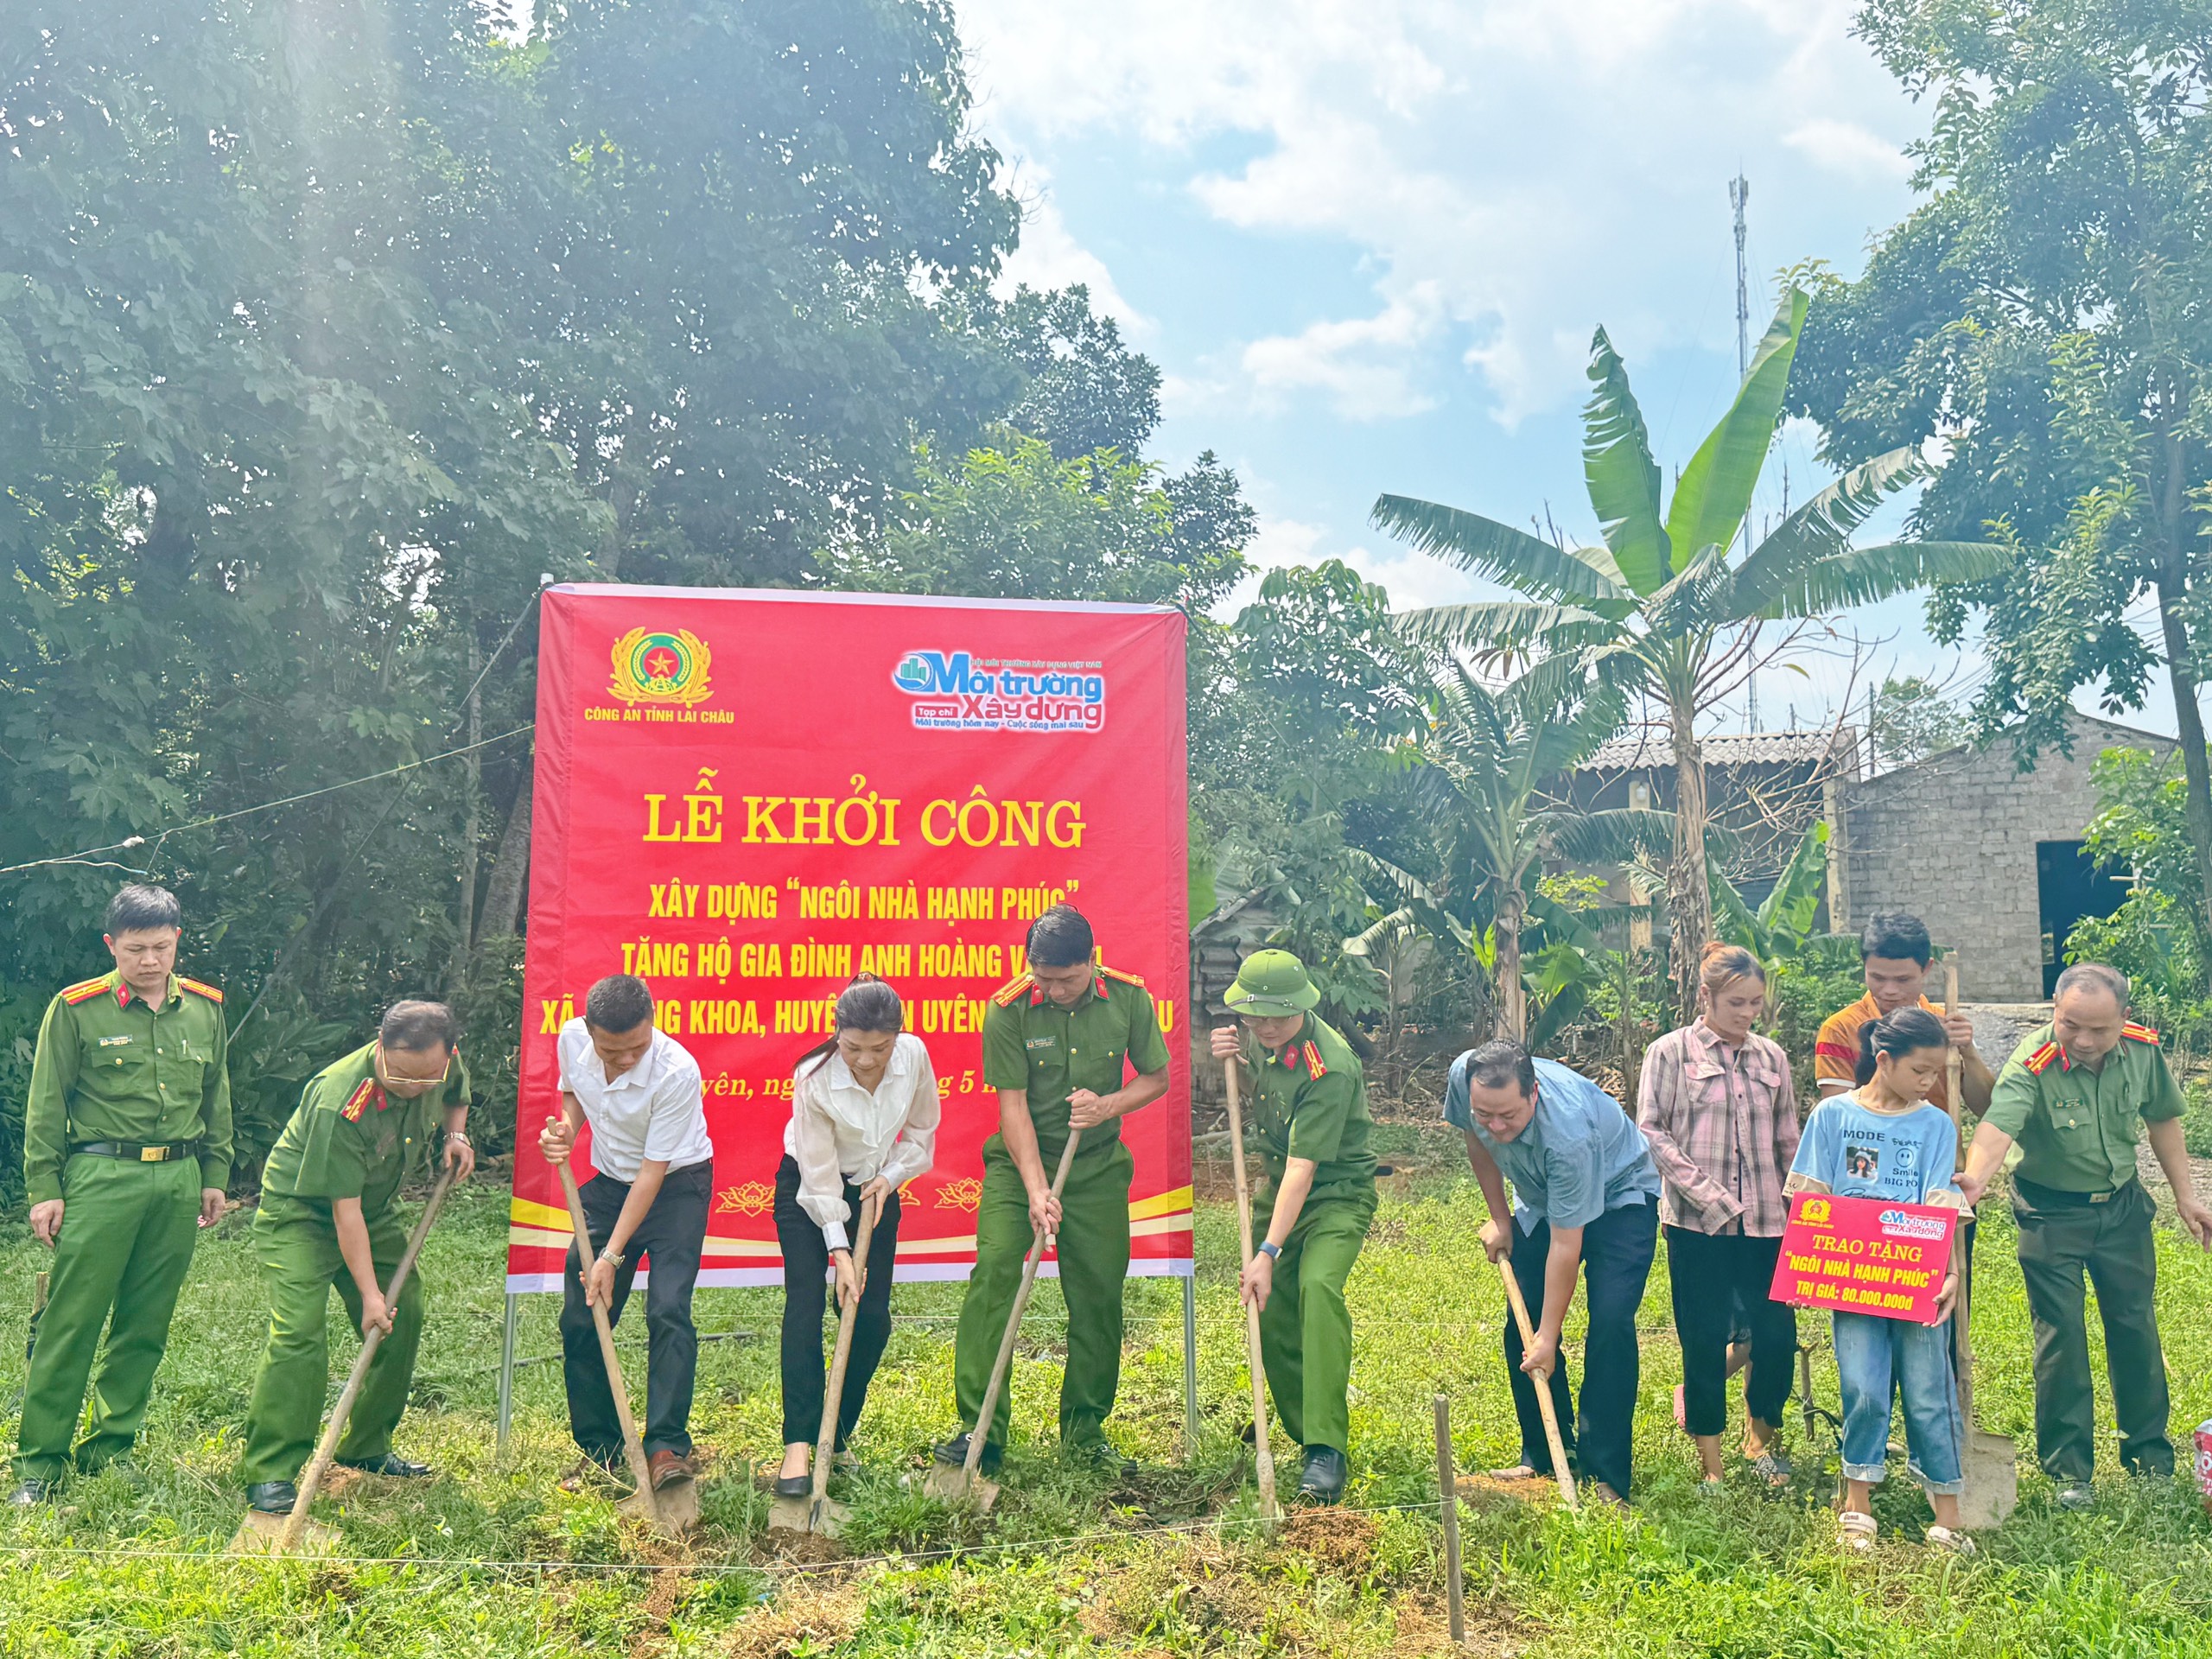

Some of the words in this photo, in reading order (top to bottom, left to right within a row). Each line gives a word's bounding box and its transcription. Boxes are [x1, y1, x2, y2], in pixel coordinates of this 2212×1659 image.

[918, 652, 994, 694] Môi
[999, 671, 1103, 703] trường
[584, 706, 620, 721] CÔNG
[623, 709, 641, 721] AN
[645, 705, 674, 721] TỈNH
[677, 710, 696, 722] LAI
[700, 709, 734, 723] CHÂU
[918, 708, 937, 717] Tạp
[938, 707, 953, 716] chí
[962, 695, 1021, 721] Xây
[1026, 696, 1103, 728] dựng
[1007, 720, 1027, 729] Cuộc
[643, 766, 723, 842] LỄ
[741, 774, 900, 846] KHỞI
[920, 785, 1087, 849] CÔNG
[648, 877, 700, 919] XÂY
[708, 881, 777, 925] DỰNG
[787, 877, 860, 919] “NGÔI
[869, 880, 919, 919] NHÀ
[927, 887, 994, 926] HẠNH
[696, 937, 732, 984] HỘ
[740, 944, 783, 977] GIA
[790, 937, 851, 977] ĐÌNH
[859, 944, 911, 977] ANH
[918, 938, 1002, 977] HOÀNG
[539, 993, 575, 1034] XÃ
[689, 999, 766, 1039] KHOA,
[774, 992, 838, 1039] HUYỆ
[959, 1070, 976, 1094] 5
[1843, 1129, 1885, 1141] MODE
[1885, 1177, 1903, 1187] BIG
[1892, 1167, 1918, 1176] Smile
[1812, 1234, 1864, 1255] TRAO
[1868, 1240, 1923, 1262] TẶNG
[1785, 1249, 1821, 1274] “NGÔI
[1822, 1259, 1850, 1278] NHÀ
[1853, 1263, 1891, 1284] HẠNH
[1892, 1268, 1939, 1288] PHÚC”
[1796, 1281, 1815, 1300] TRỊ
[1816, 1282, 1840, 1300] GIÁ:
[1841, 1287, 1915, 1311] 80.000.000đ
